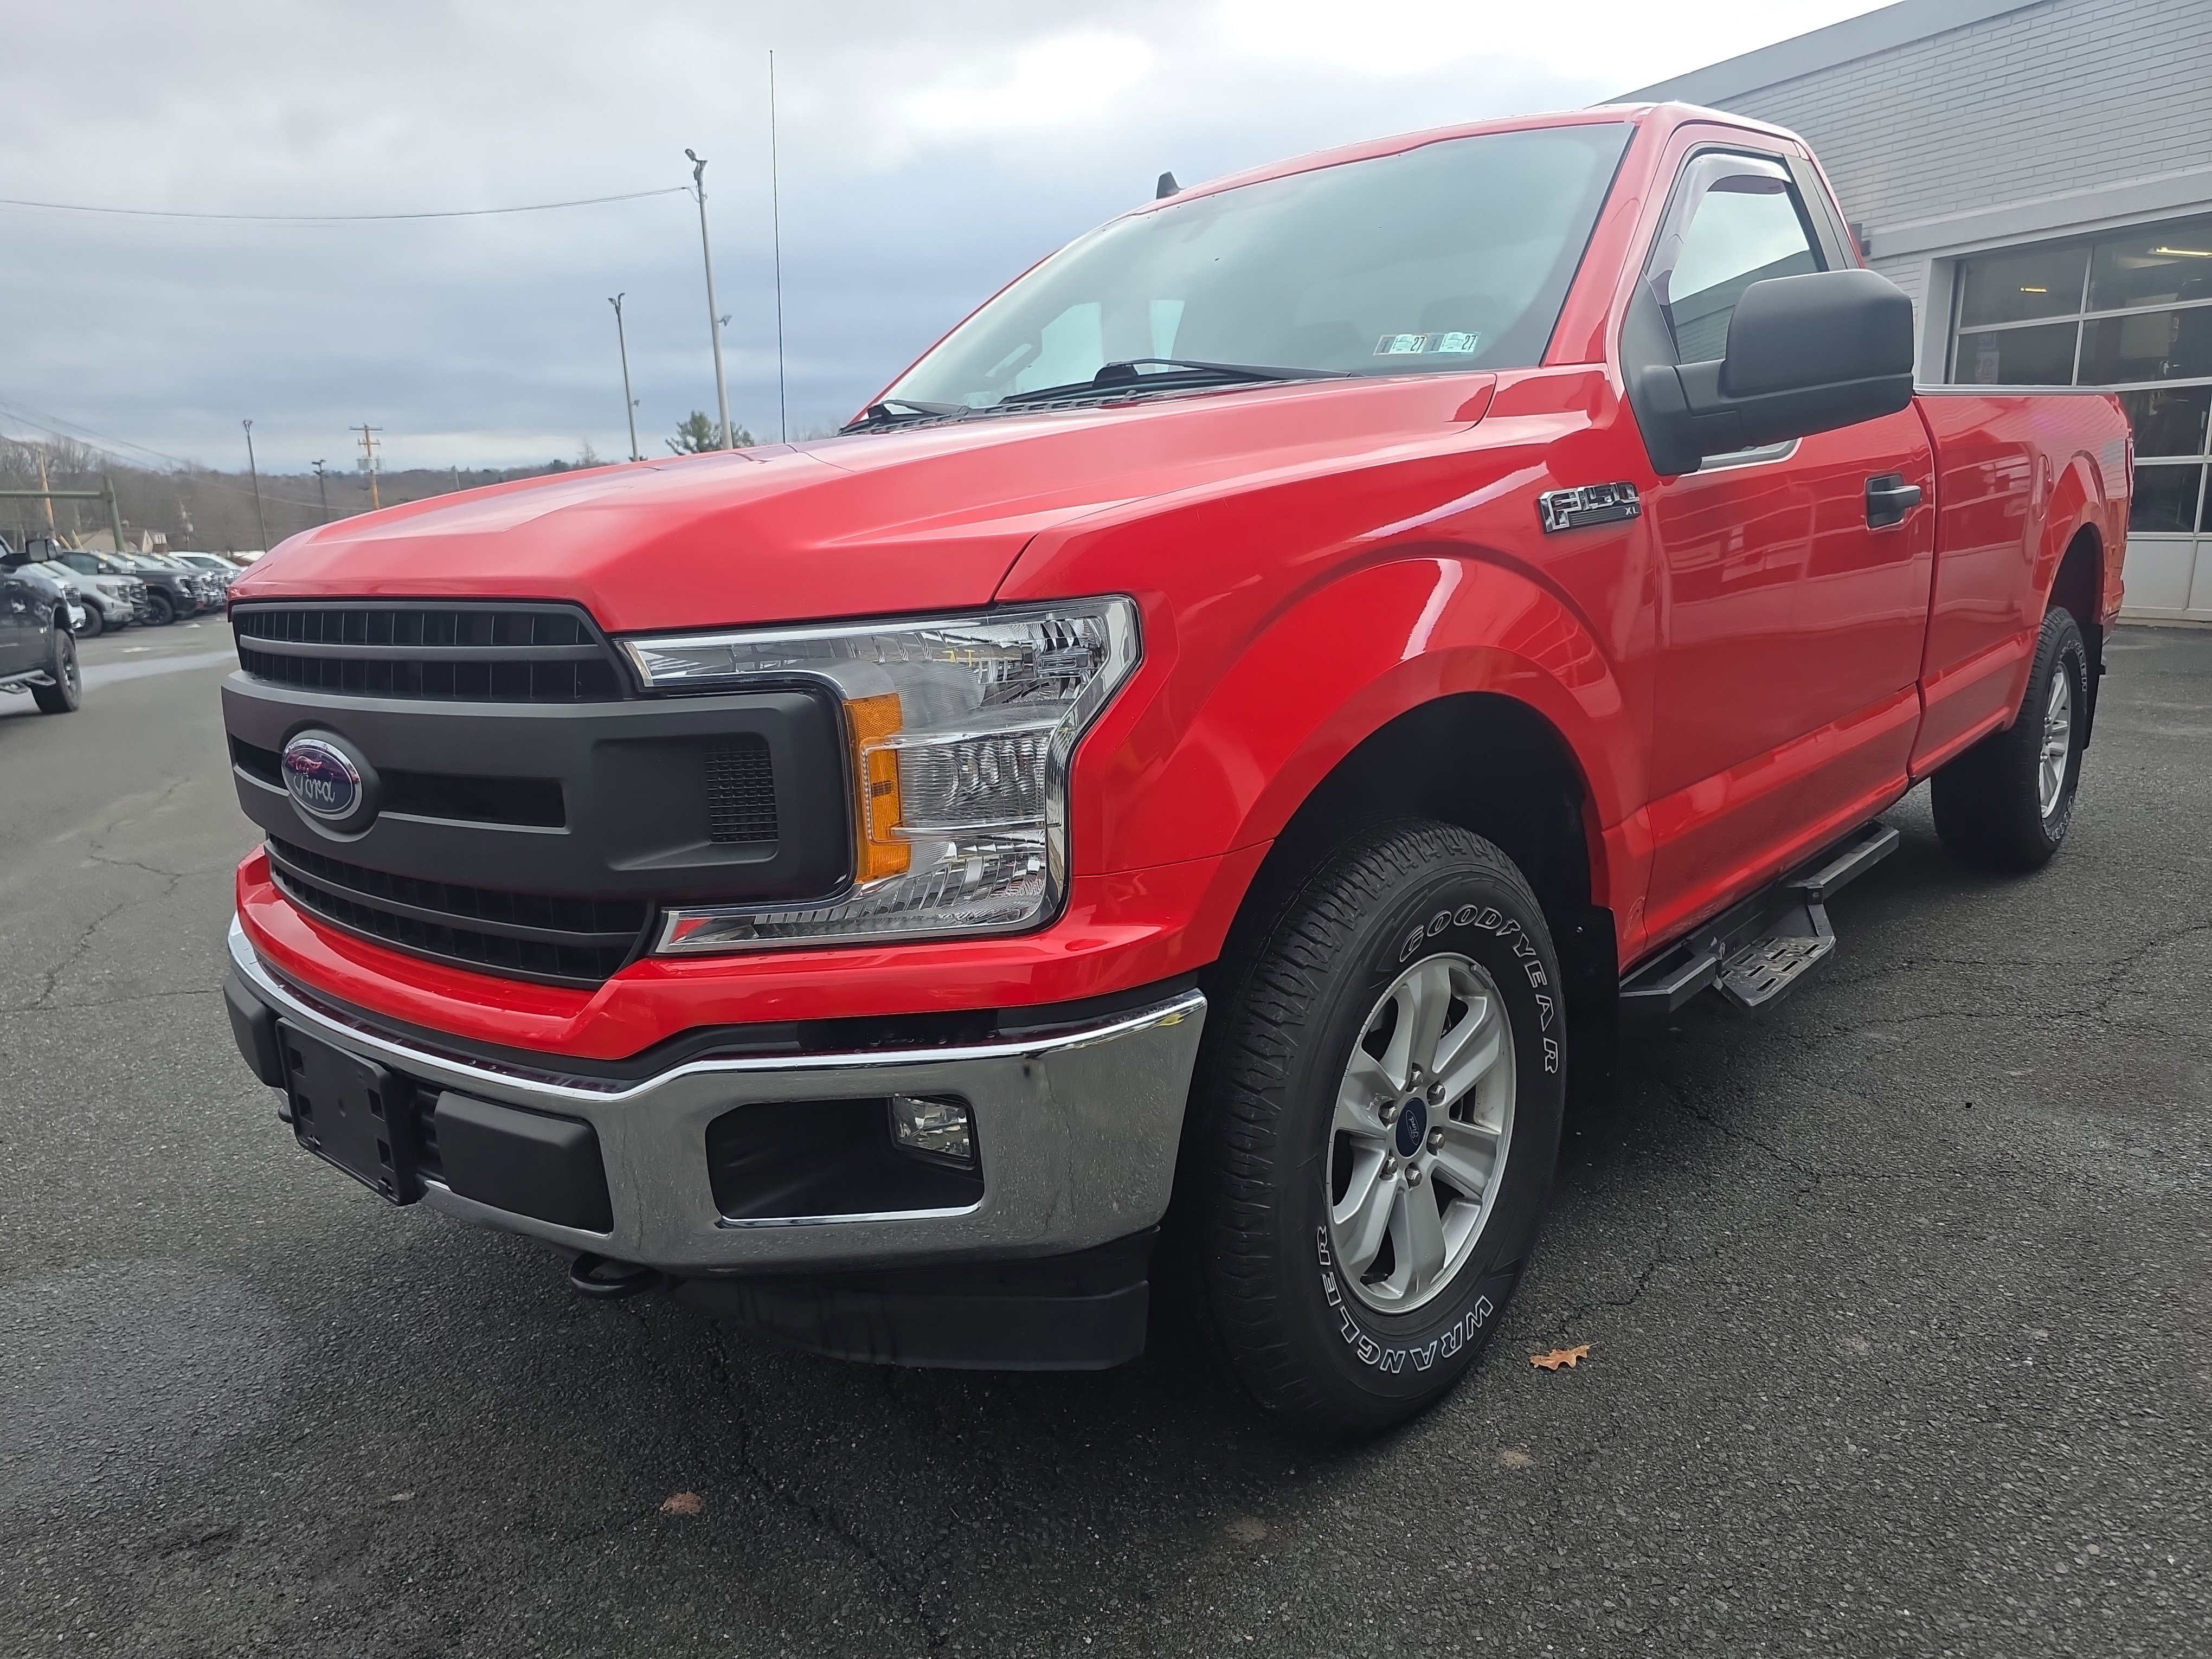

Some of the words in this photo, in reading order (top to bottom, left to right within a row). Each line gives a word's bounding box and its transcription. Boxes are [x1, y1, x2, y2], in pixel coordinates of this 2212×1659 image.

[1410, 336, 1426, 352] 27
[1462, 335, 1476, 351] 27
[1625, 506, 1639, 515] XL
[2059, 640, 2087, 692] NGLER
[293, 755, 336, 802] Ford
[2042, 796, 2073, 842] GOODY
[1399, 904, 1558, 1074] GOODYEAR
[1316, 1225, 1494, 1374] WRANGLER
